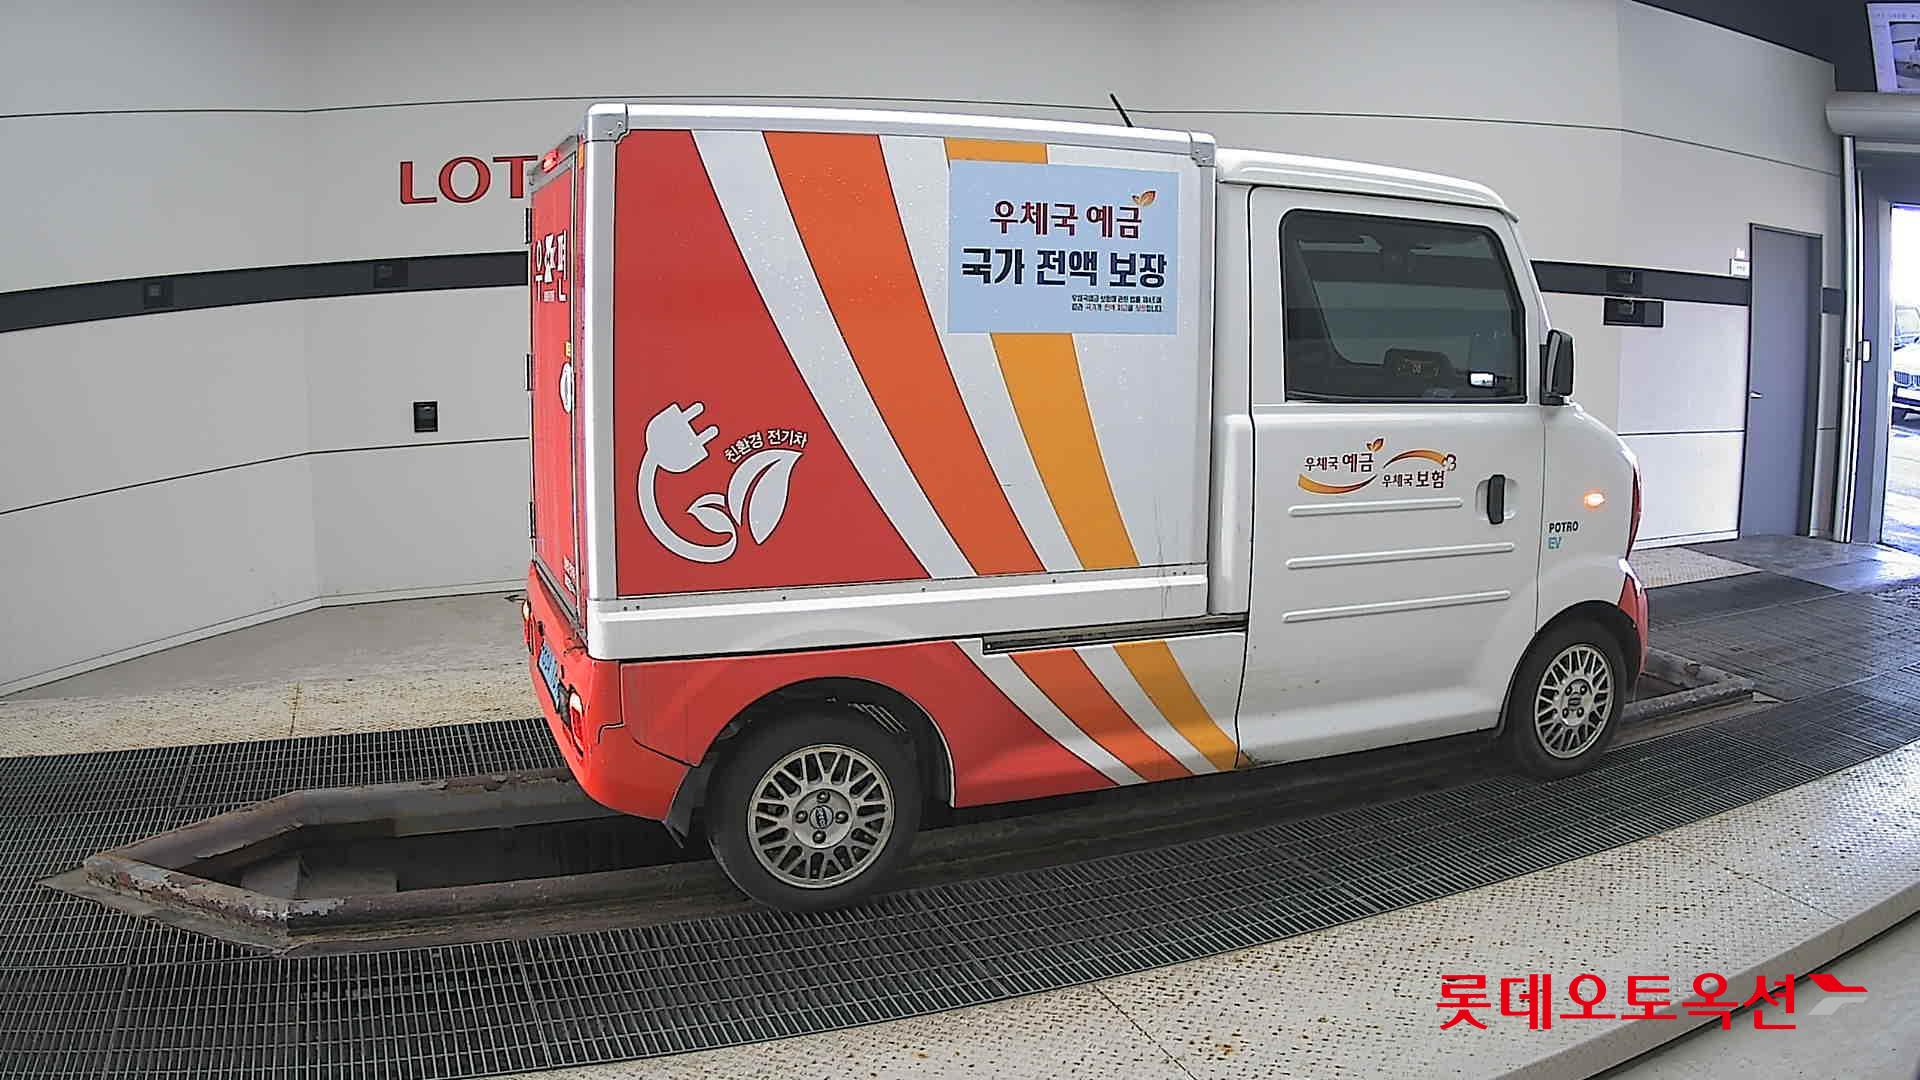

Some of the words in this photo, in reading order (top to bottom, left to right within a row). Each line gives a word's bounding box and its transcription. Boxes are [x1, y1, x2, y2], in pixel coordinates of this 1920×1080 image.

[400, 156, 538, 205] LOT
[990, 200, 1079, 237] 우체국
[1086, 205, 1142, 239] 예금
[962, 248, 1025, 285] 국가
[1036, 250, 1098, 287] 전액
[1109, 252, 1168, 289] 보장
[724, 431, 764, 463] 친환경
[767, 429, 808, 449] 전기차
[1304, 457, 1339, 472] 우체국
[1342, 453, 1375, 473] 예금
[1382, 474, 1414, 488] 우체국
[1415, 470, 1446, 489] 보험
[1548, 521, 1579, 533] POTRO
[1548, 536, 1563, 550] EV
